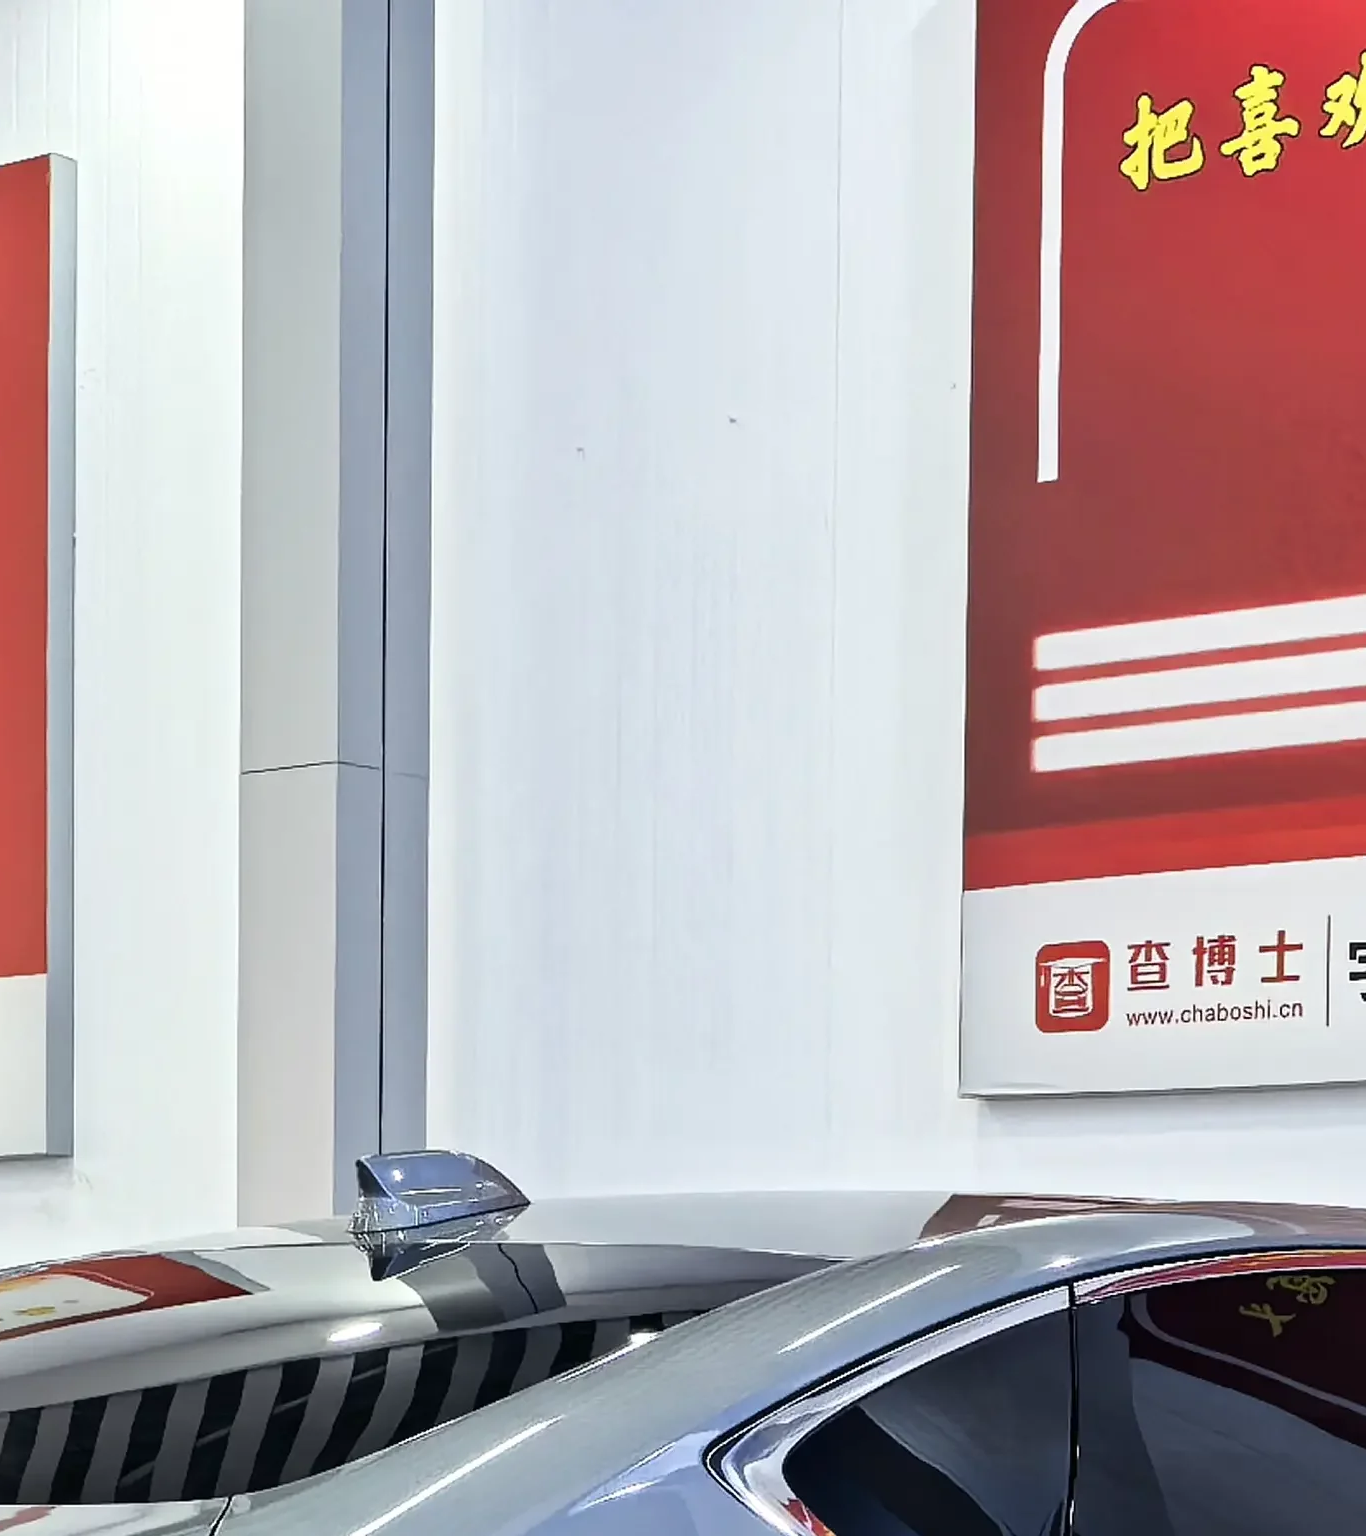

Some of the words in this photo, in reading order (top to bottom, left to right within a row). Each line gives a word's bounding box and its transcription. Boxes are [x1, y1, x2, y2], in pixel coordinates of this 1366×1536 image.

[1127, 930, 1303, 991] 查博士
[1126, 1000, 1303, 1026] www.chaboshi.cn
